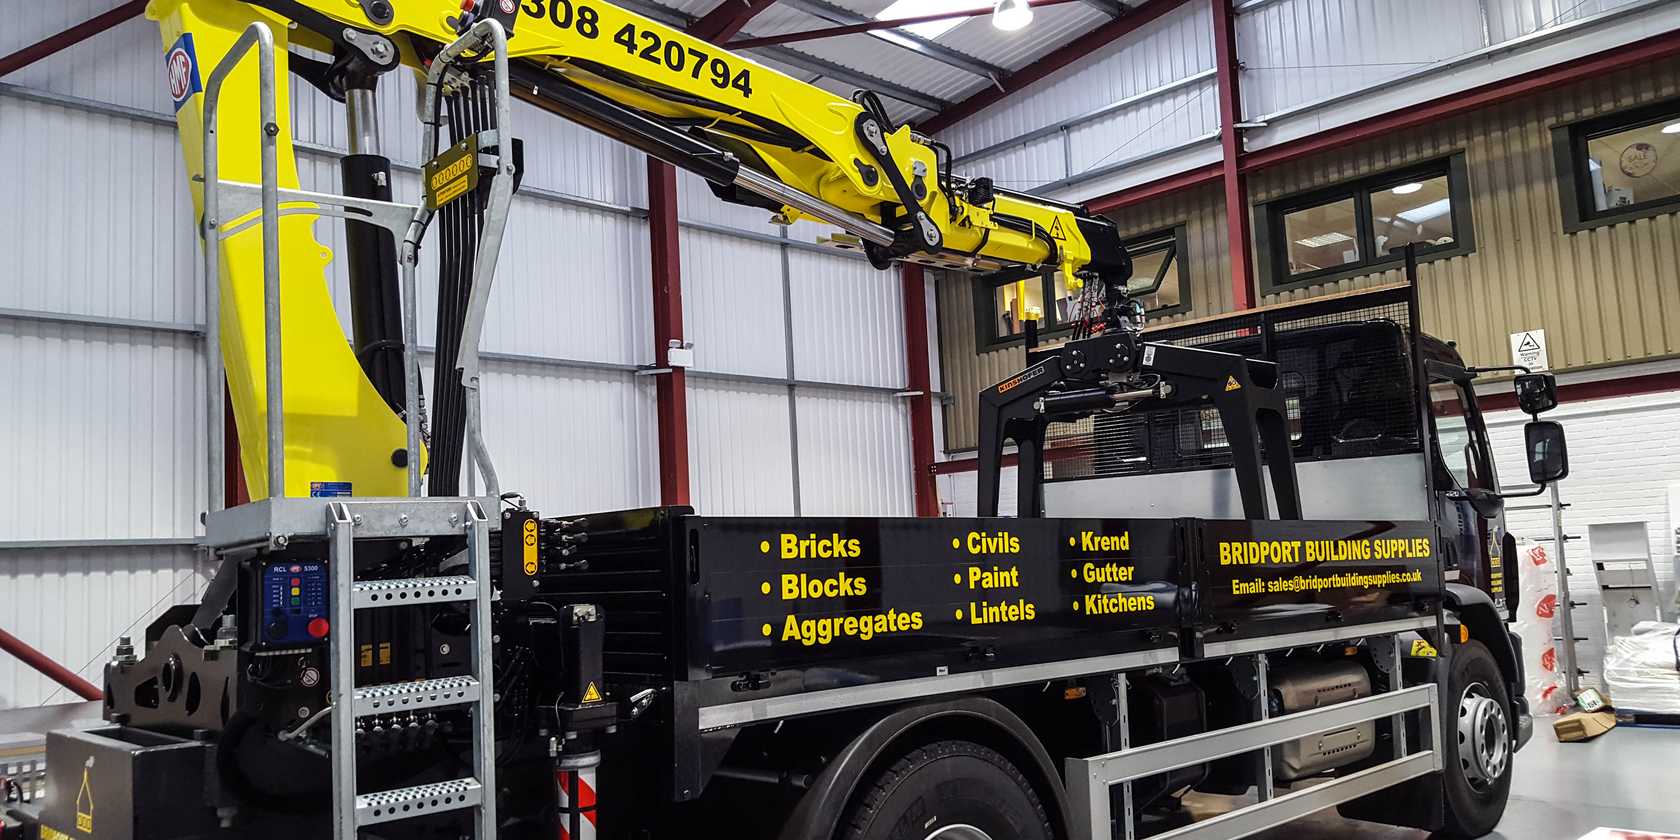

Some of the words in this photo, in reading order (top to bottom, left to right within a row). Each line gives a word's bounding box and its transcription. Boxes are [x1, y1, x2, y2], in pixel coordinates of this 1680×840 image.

[613, 23, 752, 98] 420794
[169, 53, 187, 96] HMF
[780, 533, 861, 559] Bricks
[967, 532, 1020, 554] Civils
[1081, 531, 1129, 551] Krend
[1219, 541, 1301, 565] BRIDPORT
[1305, 540, 1371, 562] BUILDING
[1373, 538, 1430, 560] SUPPLIES
[781, 571, 867, 600] Blocks
[968, 566, 1018, 589] Paint
[1083, 562, 1134, 583] Gutter
[1232, 578, 1265, 595] Email:
[1267, 569, 1422, 593] sales@bridportbuildingsupplies.co.uk
[970, 599, 1036, 624] Lintels
[1085, 593, 1155, 615] Kitchens
[781, 608, 923, 646] Aggregates
